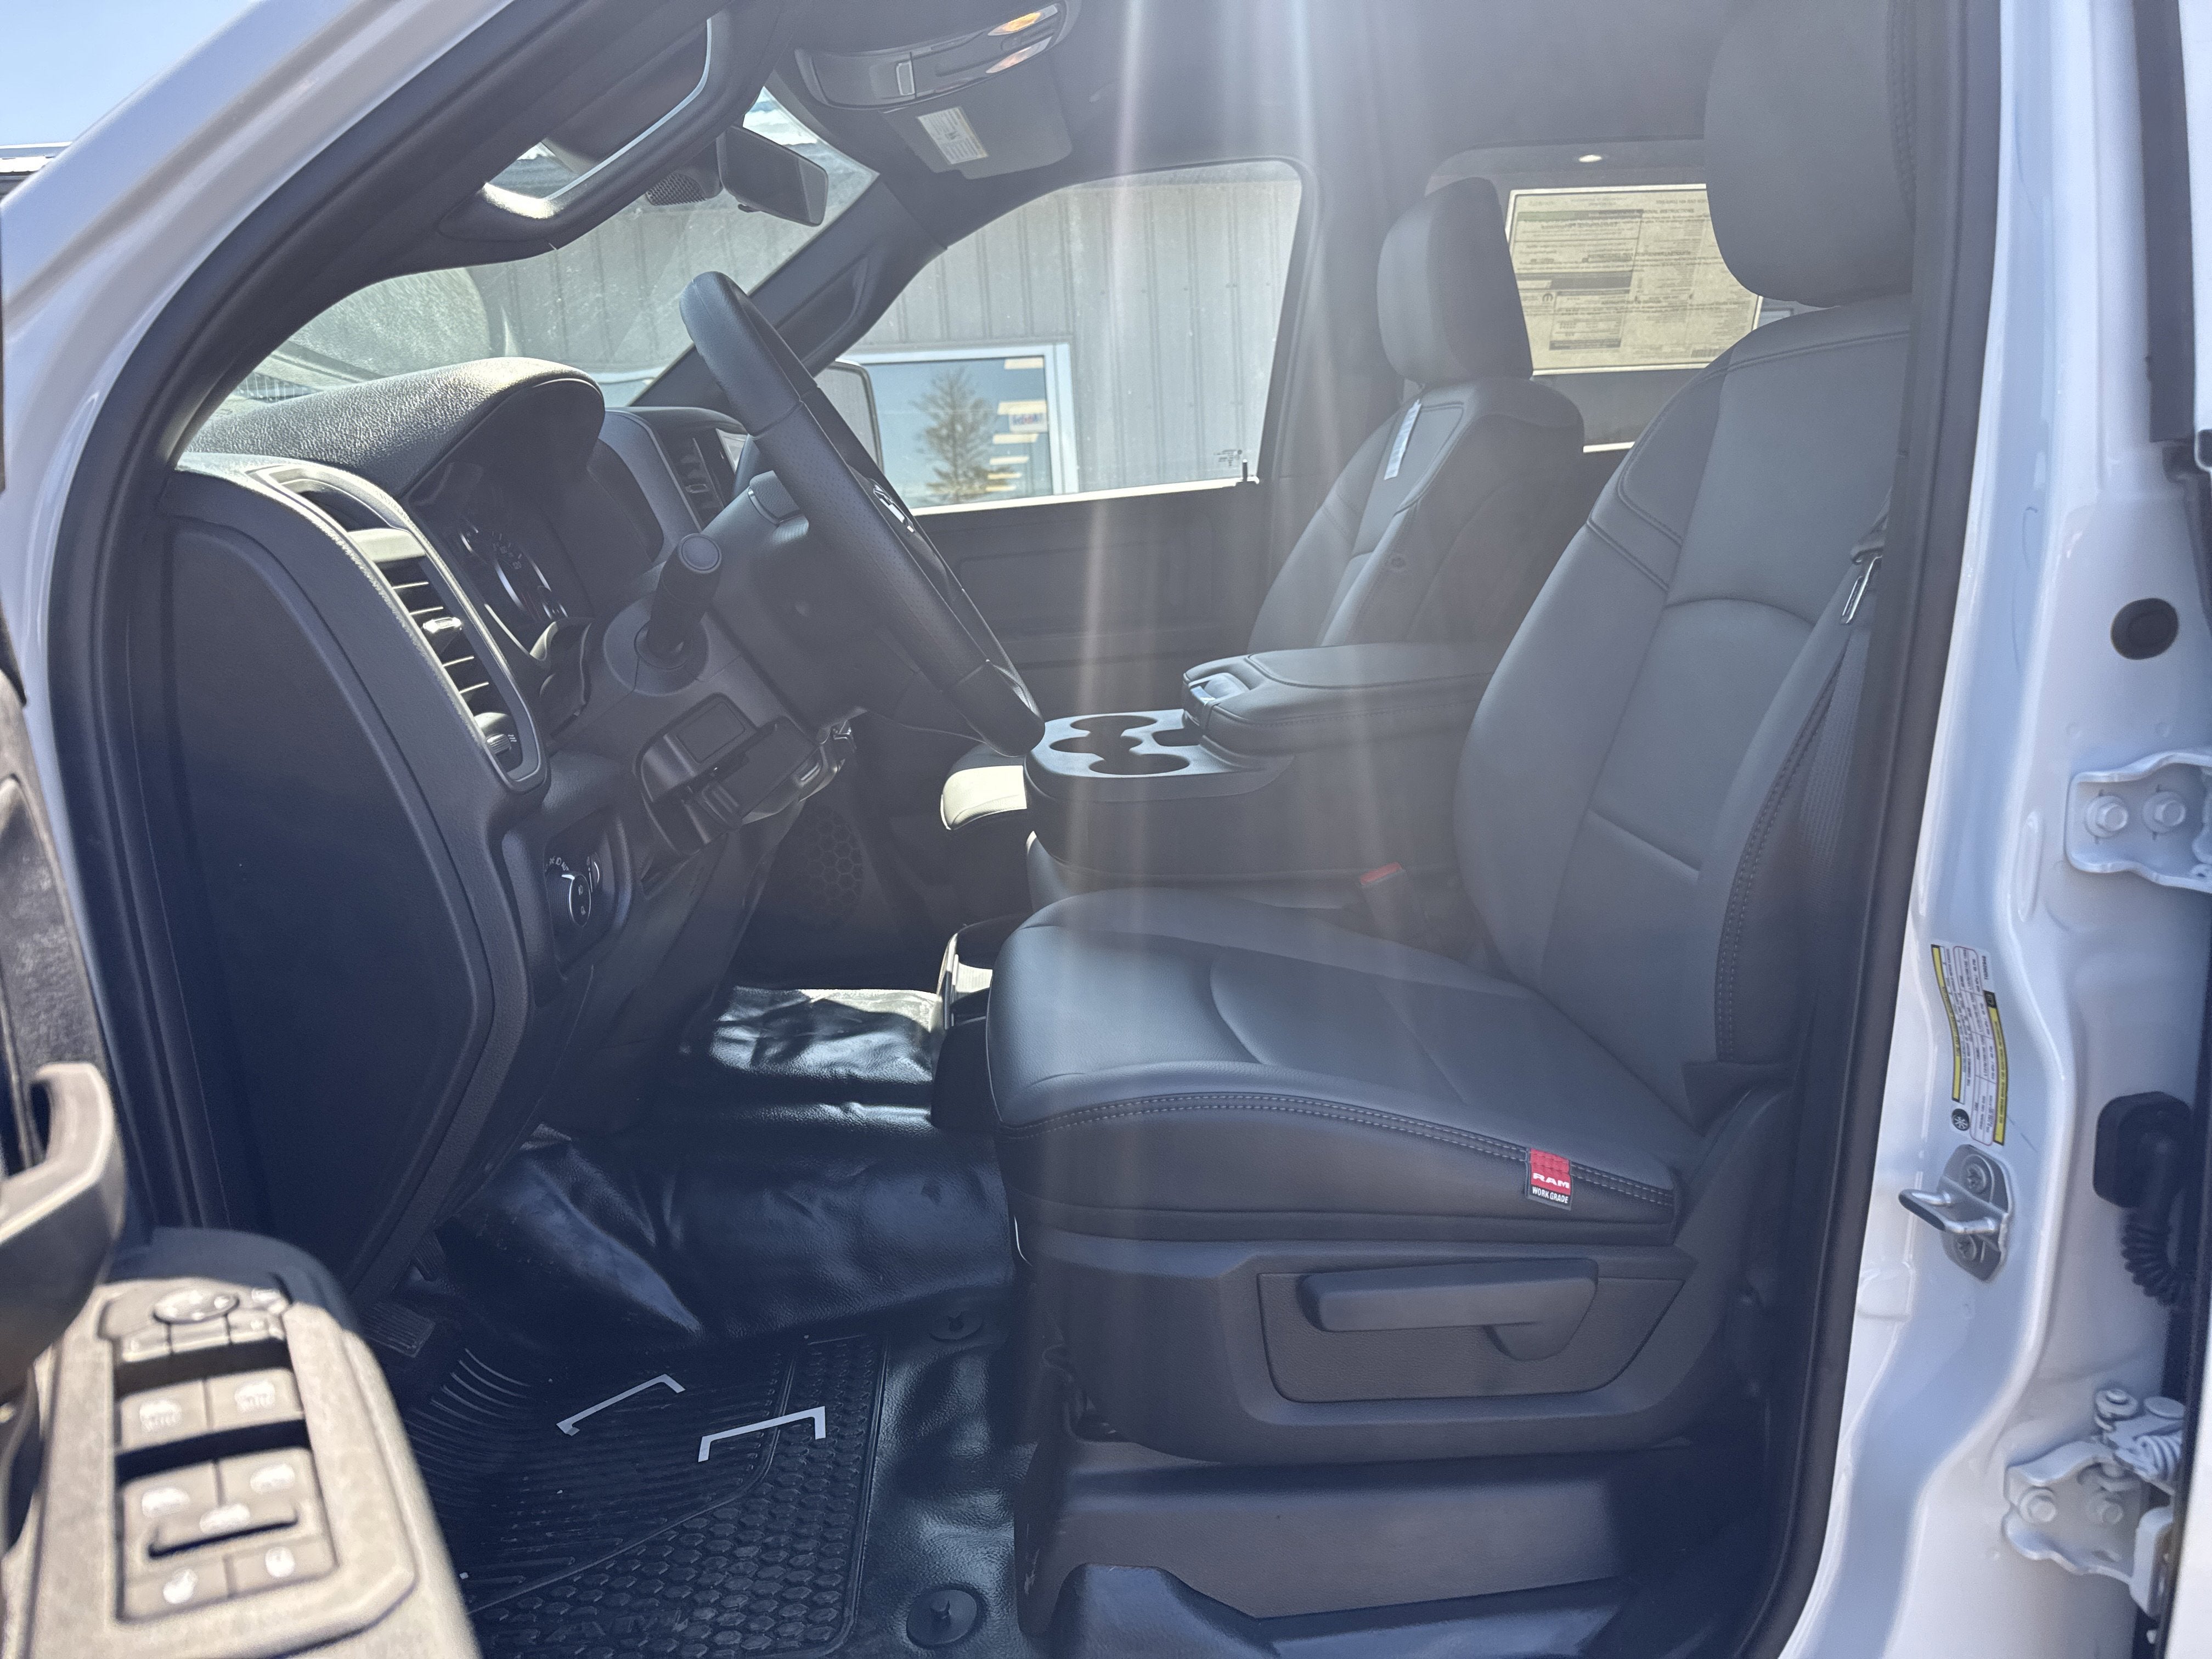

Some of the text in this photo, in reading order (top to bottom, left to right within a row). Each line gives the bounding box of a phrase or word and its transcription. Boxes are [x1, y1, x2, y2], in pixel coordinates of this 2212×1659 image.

[1533, 1172, 1570, 1189] RAM
[1532, 1186, 1568, 1204] WORK GRADE
